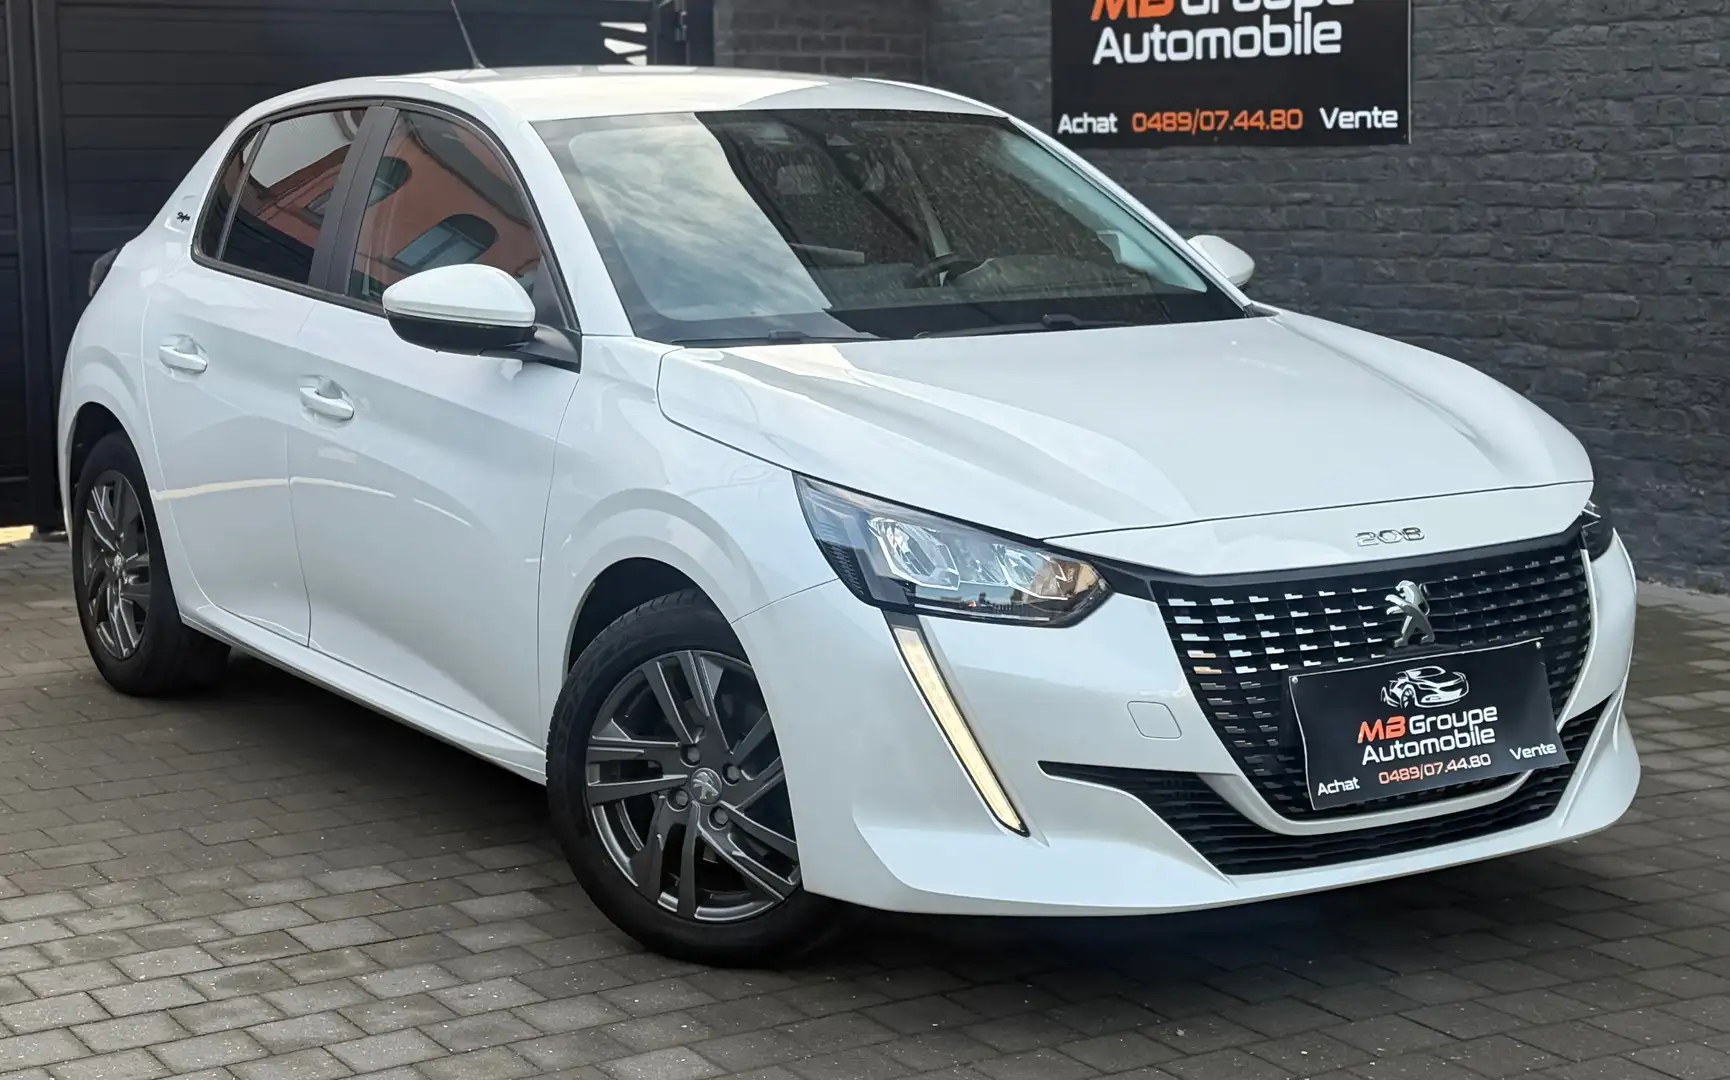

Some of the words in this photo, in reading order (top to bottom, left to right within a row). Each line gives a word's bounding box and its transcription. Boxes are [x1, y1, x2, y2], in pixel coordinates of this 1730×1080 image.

[1092, 11, 1343, 65] Automobile
[1057, 112, 1118, 134] Achat
[1131, 108, 1304, 135] 0489/07.44.80
[1319, 106, 1398, 130] Vente
[1355, 526, 1425, 547] 208
[1408, 706, 1498, 735] Groupe
[1362, 724, 1496, 765] Automobile
[1317, 776, 1360, 796] Achat
[1378, 753, 1492, 785] 0489/07.44.80
[1508, 742, 1558, 760] Vente
